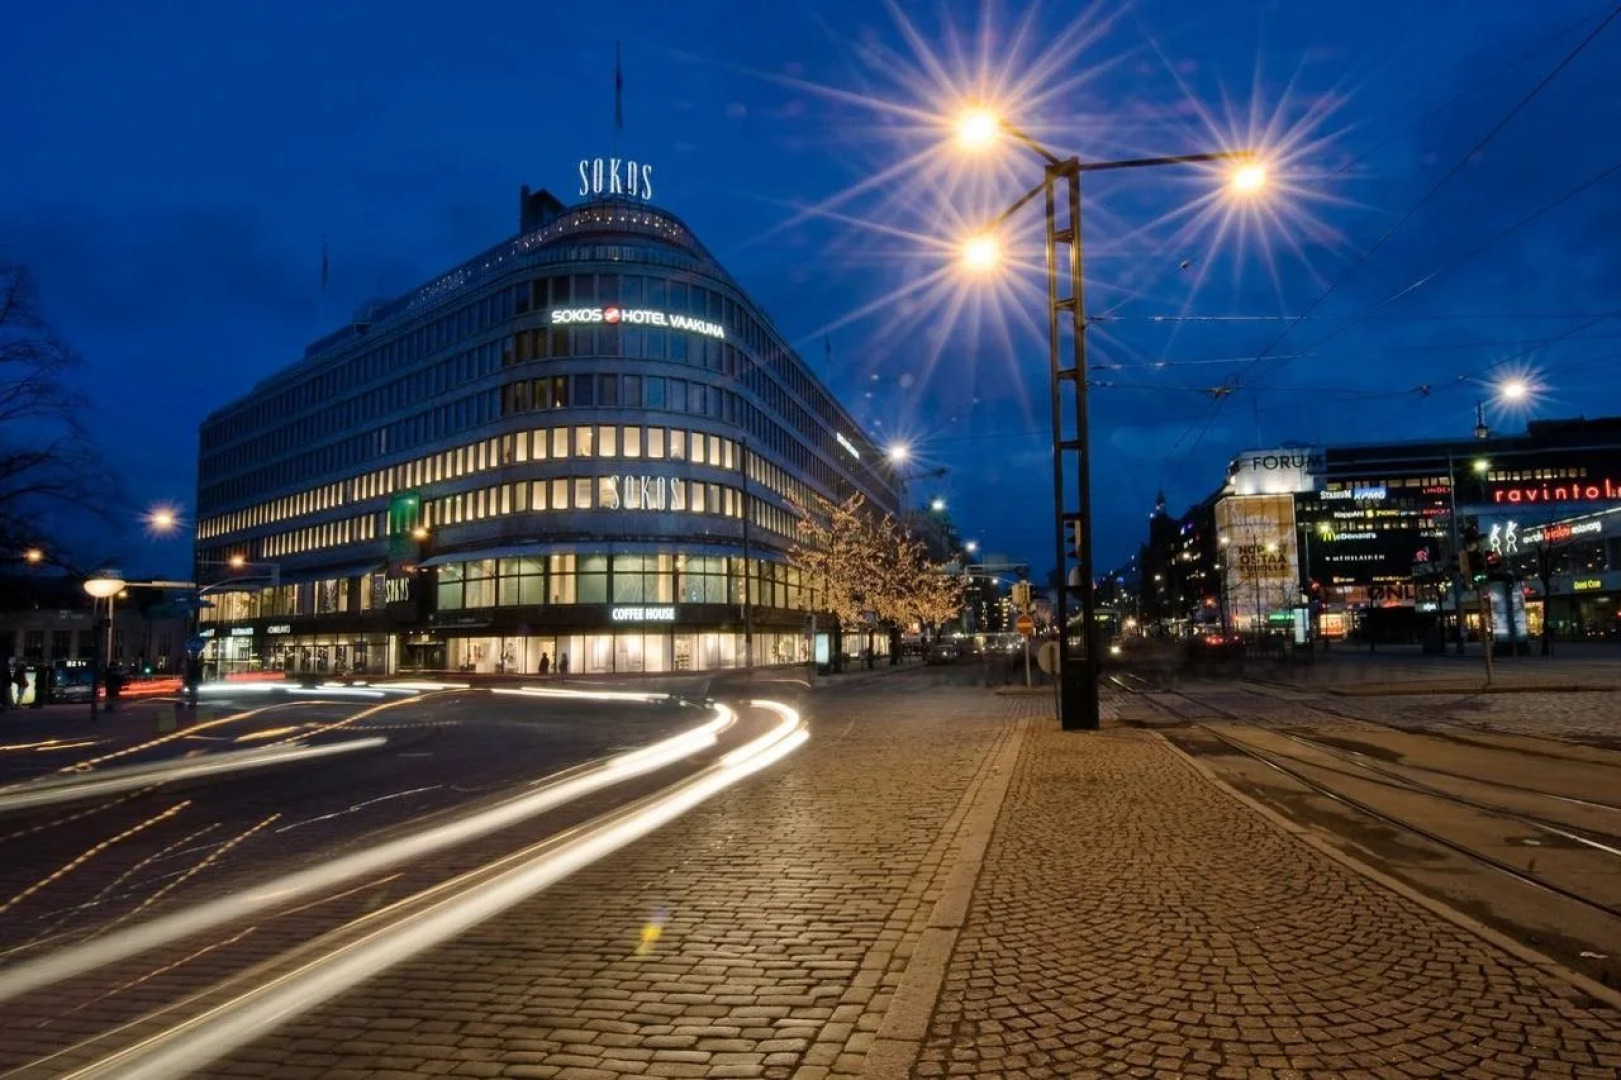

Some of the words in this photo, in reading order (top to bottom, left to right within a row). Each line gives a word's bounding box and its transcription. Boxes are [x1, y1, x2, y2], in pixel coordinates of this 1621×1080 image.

[580, 158, 652, 200] SOKOS
[552, 309, 602, 323] SOKOS
[622, 309, 668, 325] HOTEL
[670, 314, 725, 338] VAAKUNA
[610, 475, 680, 510] SOKOS
[612, 608, 643, 620] COFFEE
[646, 608, 675, 620] HOUSE
